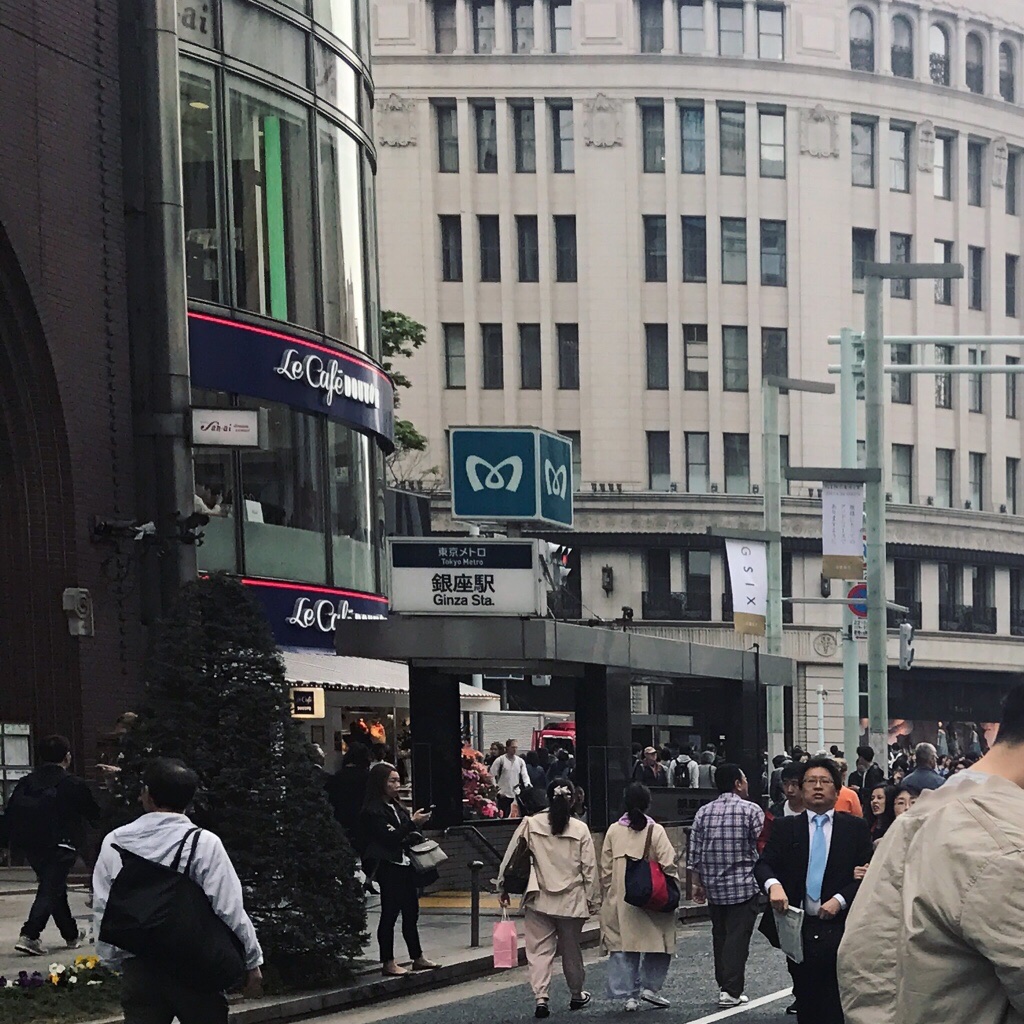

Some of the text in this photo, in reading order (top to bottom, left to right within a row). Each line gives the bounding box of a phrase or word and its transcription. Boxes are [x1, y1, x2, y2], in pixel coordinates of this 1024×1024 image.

[273, 349, 304, 381] Le
[305, 354, 343, 406] Café
[438, 547, 486, 557] 東京メトロ
[441, 558, 484, 567] Tokyo Metro
[431, 574, 495, 594] 銀座駅
[741, 546, 757, 606] GSIX
[433, 594, 495, 606] Ginza Sta.
[285, 597, 315, 629] Le
